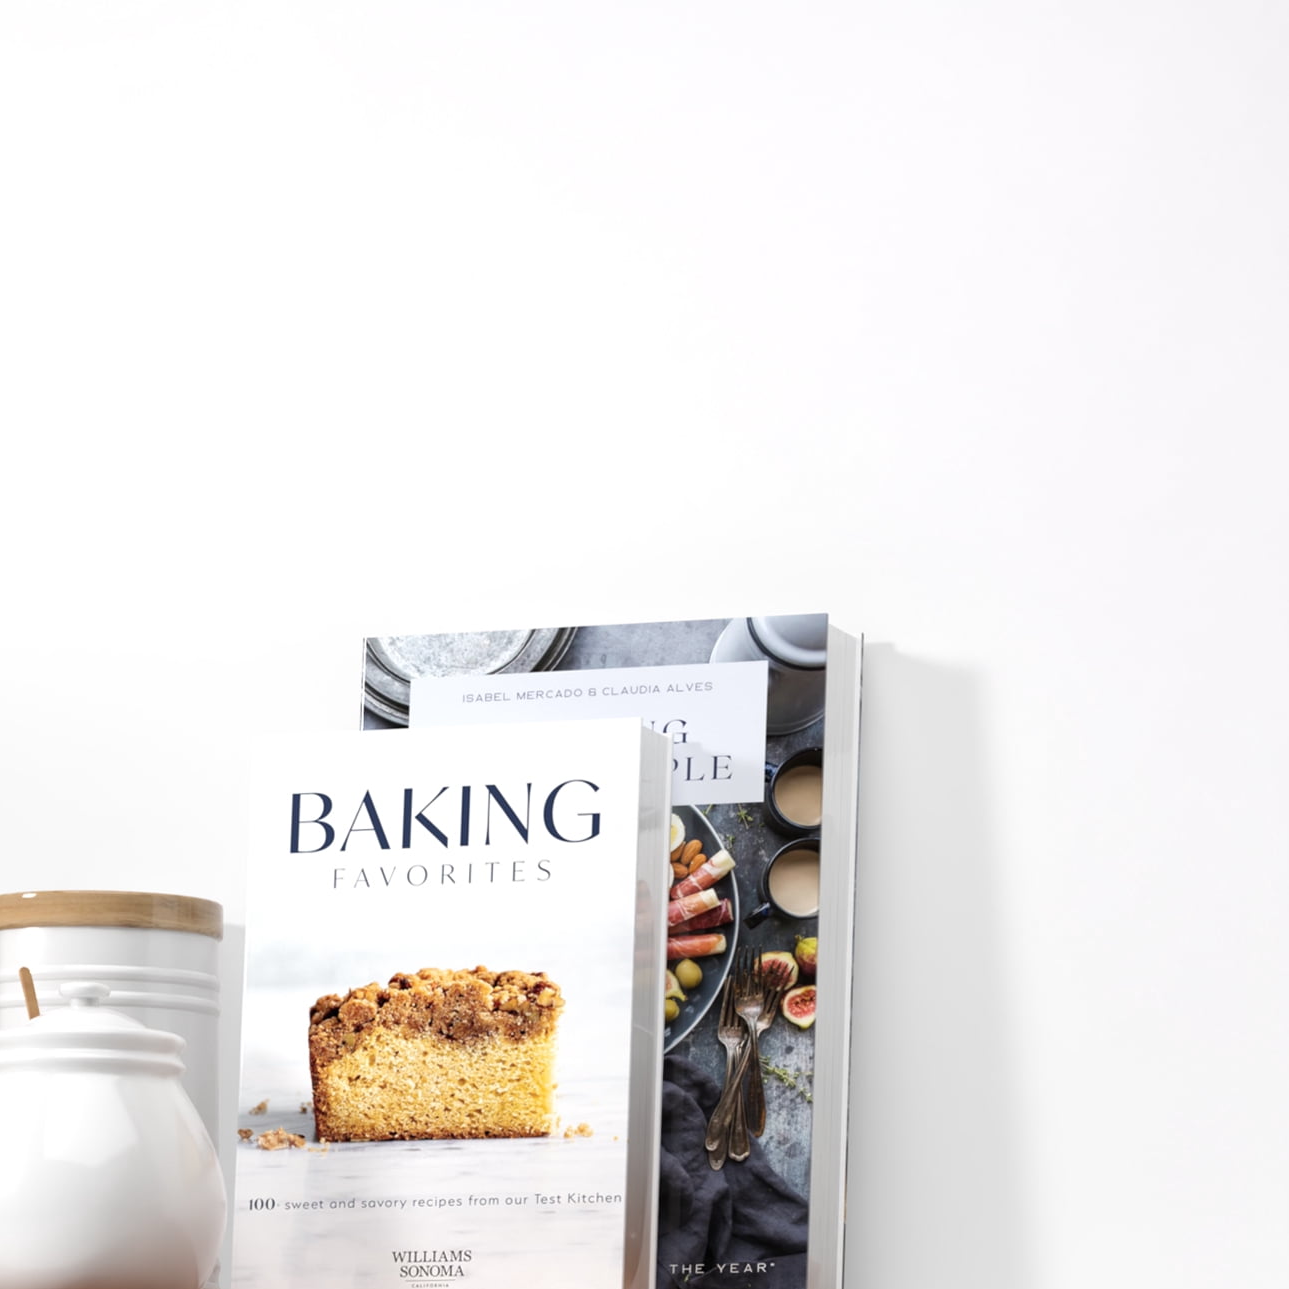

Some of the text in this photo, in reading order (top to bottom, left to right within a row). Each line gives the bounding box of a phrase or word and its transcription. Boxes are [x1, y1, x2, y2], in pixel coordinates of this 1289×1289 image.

[462, 681, 714, 703] ISABEL MERCADO & CLAUDIA ALVES
[289, 779, 602, 854] BAKING
[333, 859, 553, 889] FAVORITES
[285, 1200, 323, 1210] sweet
[329, 1198, 355, 1209] and
[361, 1199, 407, 1209] savory
[412, 1197, 463, 1208] recipes
[468, 1195, 500, 1206] from
[505, 1196, 528, 1205] our
[535, 1193, 562, 1204] Test
[567, 1192, 622, 1204] Kitchen
[392, 1250, 472, 1263] WILLIAMS
[399, 1265, 464, 1278] SONOMA
[669, 1264, 705, 1275] THE
